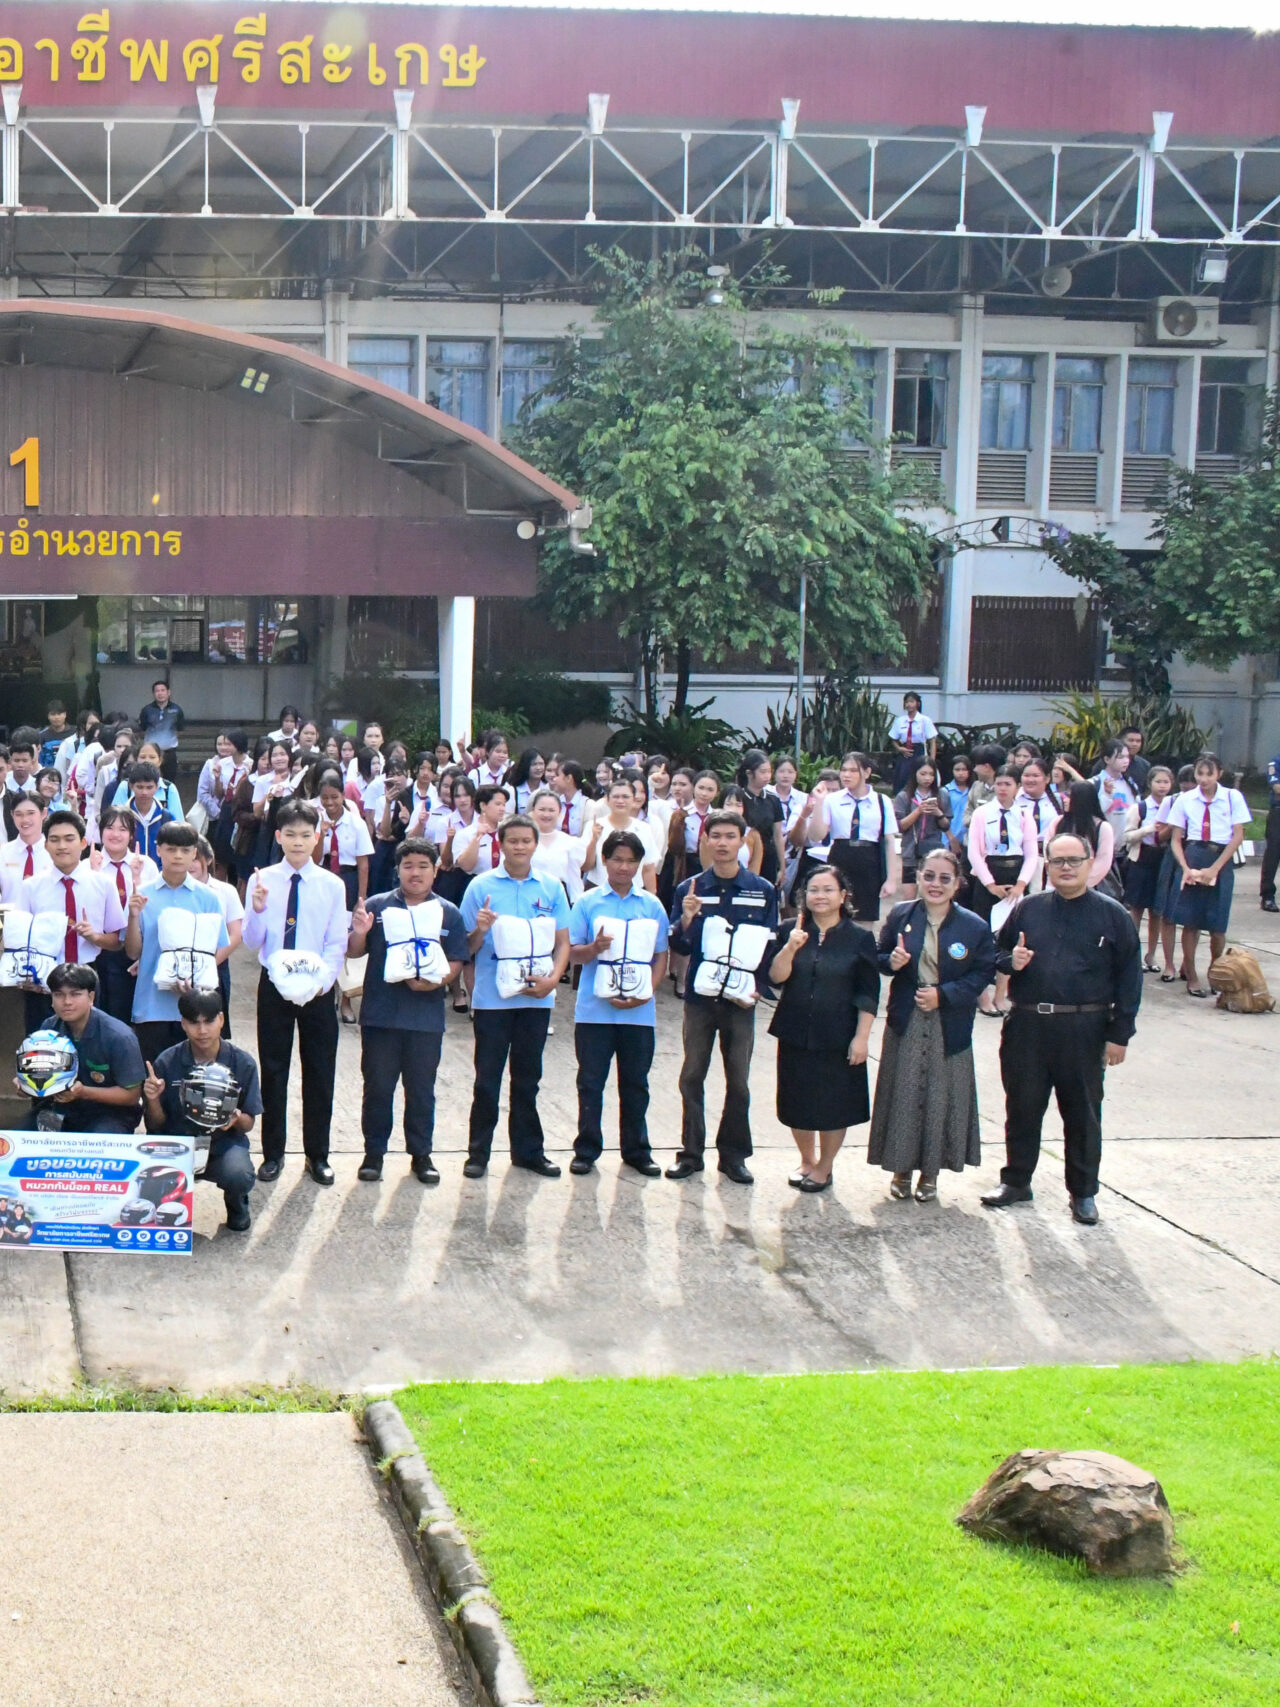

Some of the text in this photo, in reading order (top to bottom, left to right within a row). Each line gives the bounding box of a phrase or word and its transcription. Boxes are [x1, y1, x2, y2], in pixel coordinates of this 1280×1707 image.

[10, 437, 40, 507] 1
[21, 1138, 132, 1149] วิทยาลัยการอาชีพศรีสะเกษ
[26, 1158, 125, 1174] ขอขอบคุณ
[44, 1170, 104, 1180] การสนับสนุน
[25, 1180, 124, 1193] หมวกกันน็อค REAL
